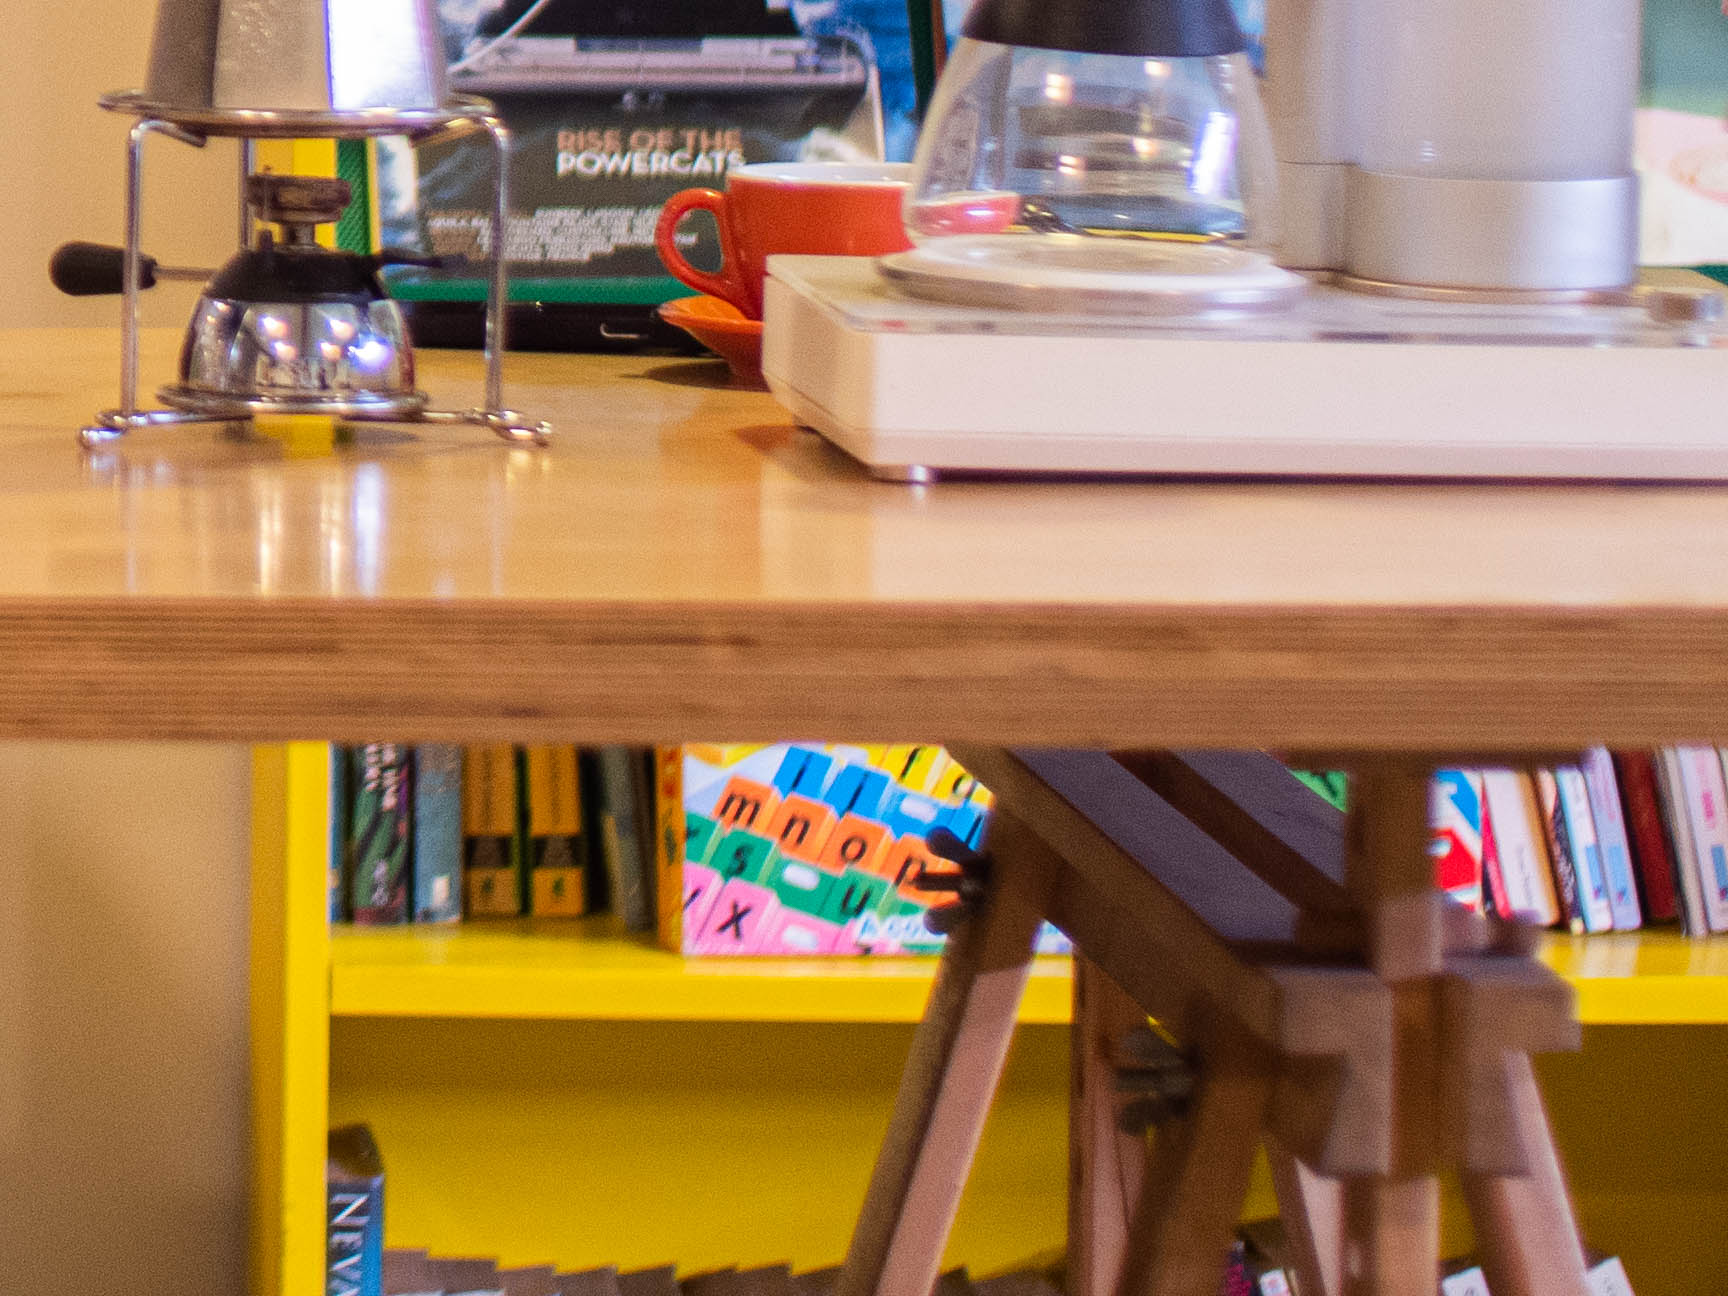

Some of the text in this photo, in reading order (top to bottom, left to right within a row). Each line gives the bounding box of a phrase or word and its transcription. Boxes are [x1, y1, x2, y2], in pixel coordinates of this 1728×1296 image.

[557, 128, 744, 151] RISE OF THE
[556, 151, 747, 177] POWERCATS
[719, 792, 761, 828] m
[779, 814, 811, 846] n
[840, 836, 868, 863] o
[726, 845, 872, 917] s u
[716, 898, 752, 942] x
